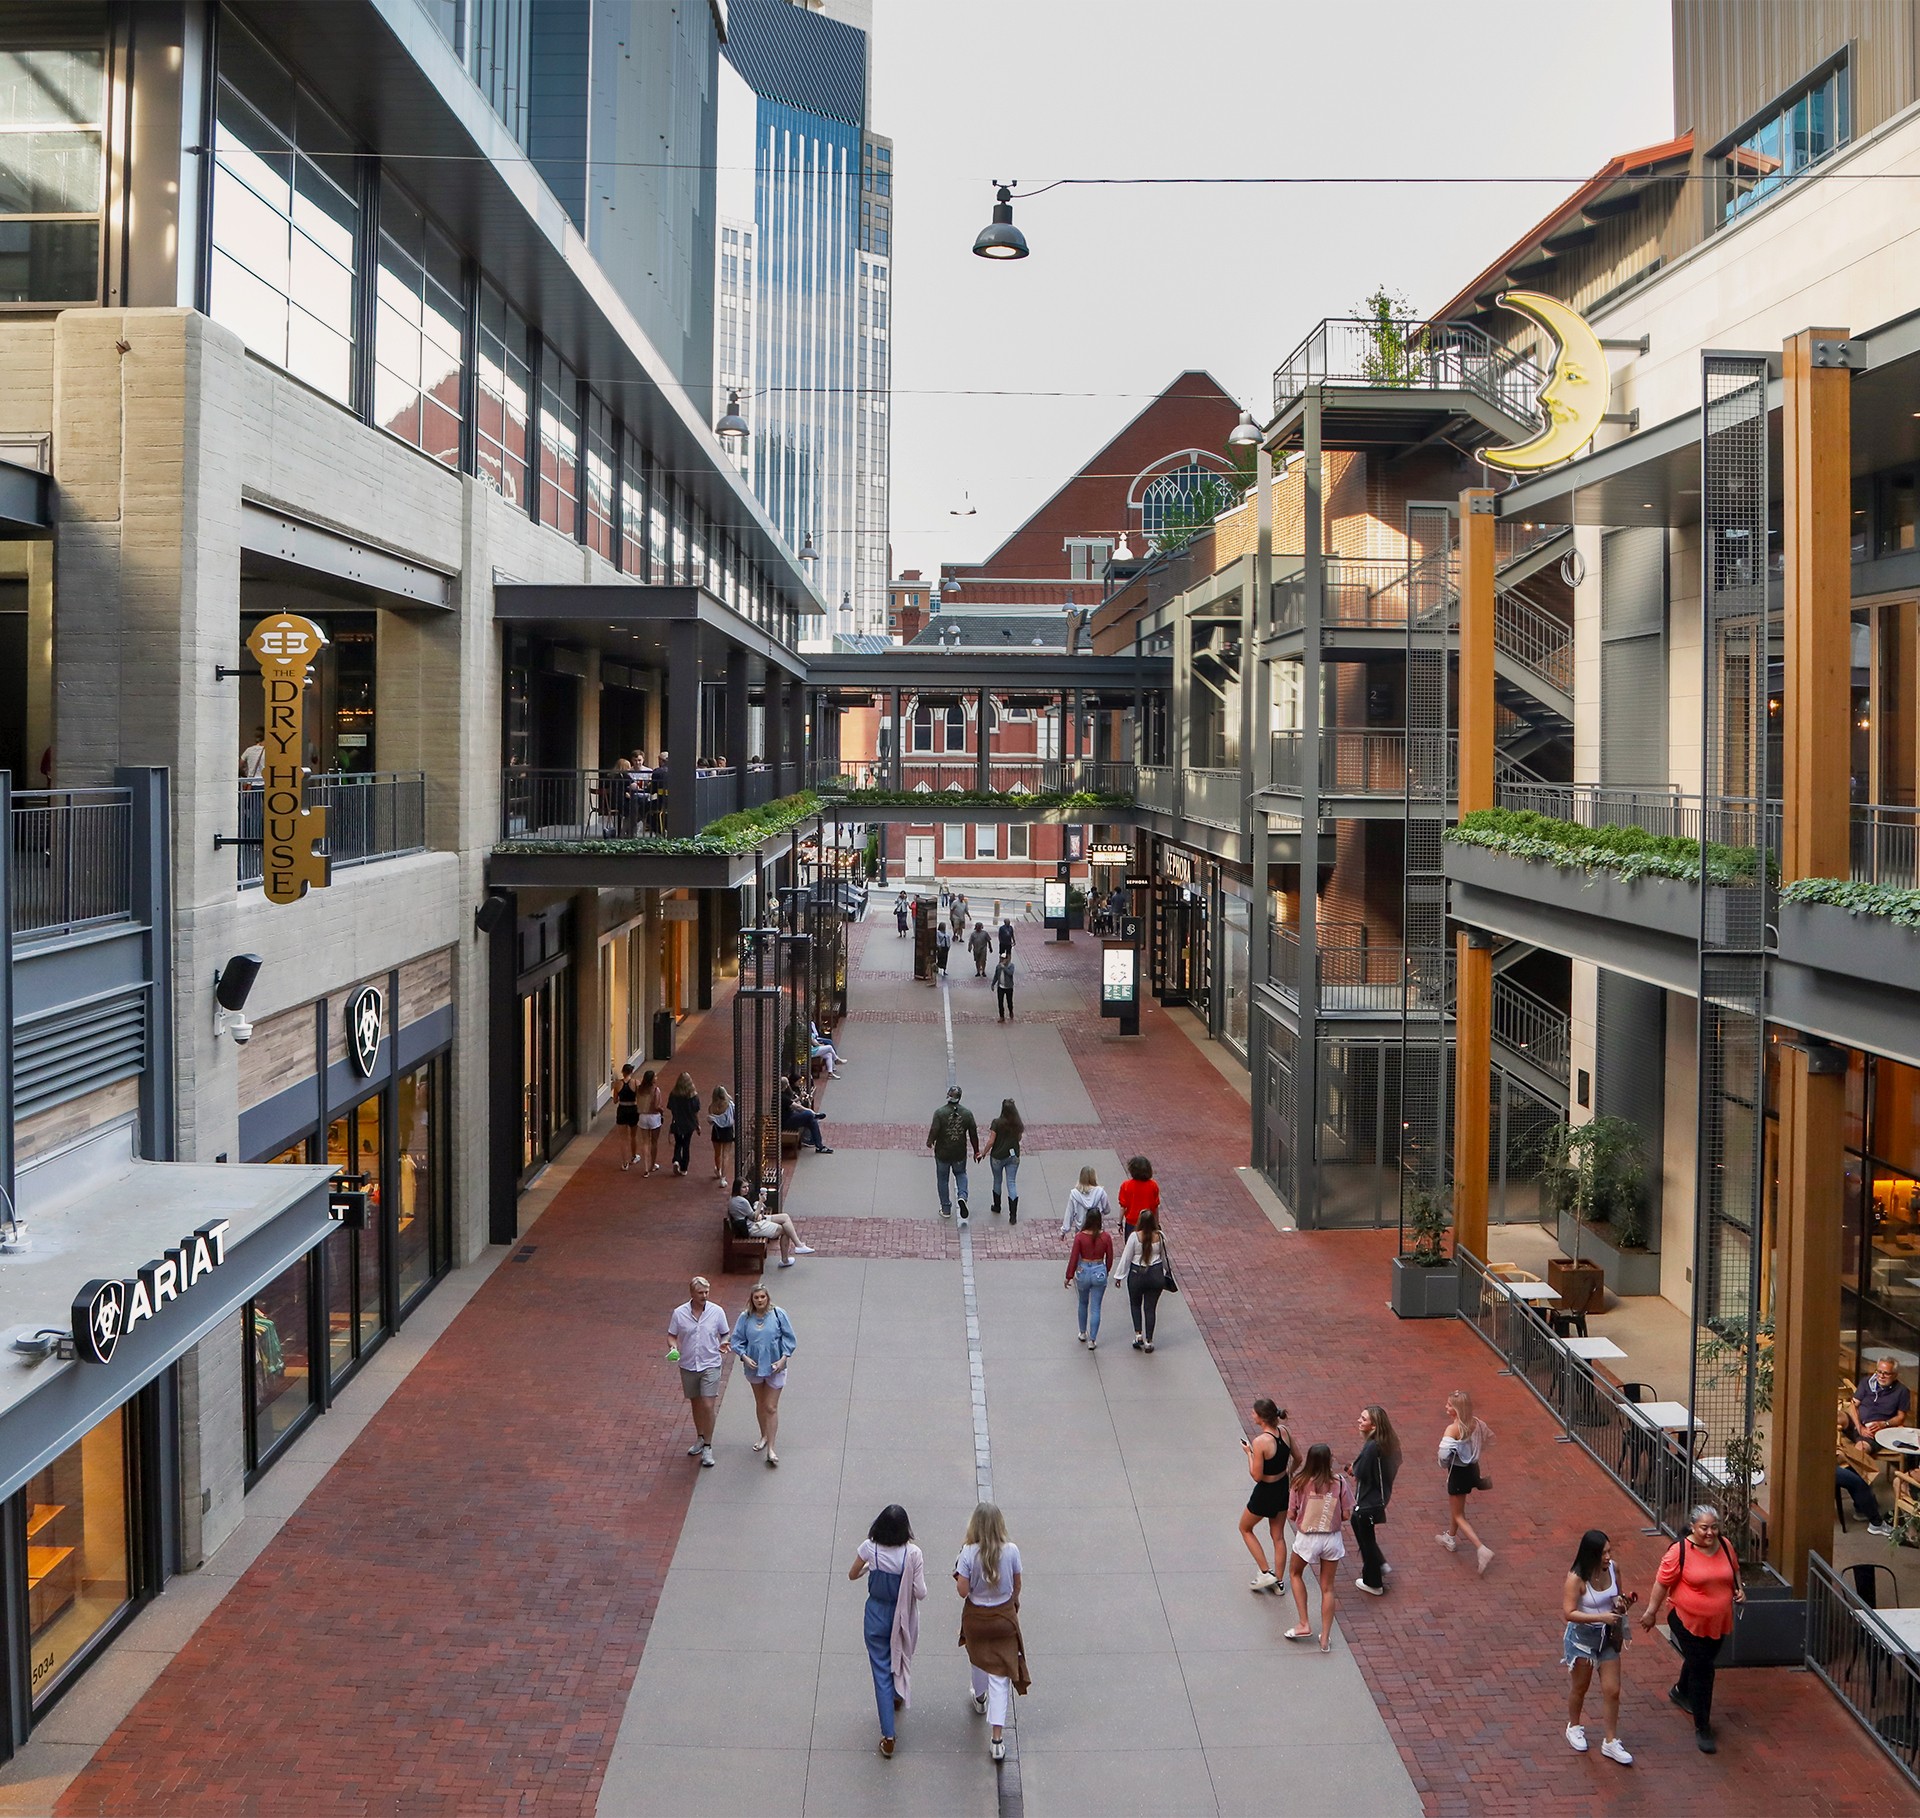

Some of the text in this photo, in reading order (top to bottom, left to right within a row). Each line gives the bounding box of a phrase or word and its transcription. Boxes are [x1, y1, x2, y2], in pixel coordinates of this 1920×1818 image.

[273, 669, 296, 677] THE
[1370, 690, 1377, 700] 2
[267, 679, 298, 895] DRY HOUSE
[1092, 844, 1128, 852] TECOVAS
[1166, 852, 1191, 884] SEPHORA
[126, 1219, 230, 1334] ARIAT
[32, 1651, 55, 1685] 5034
